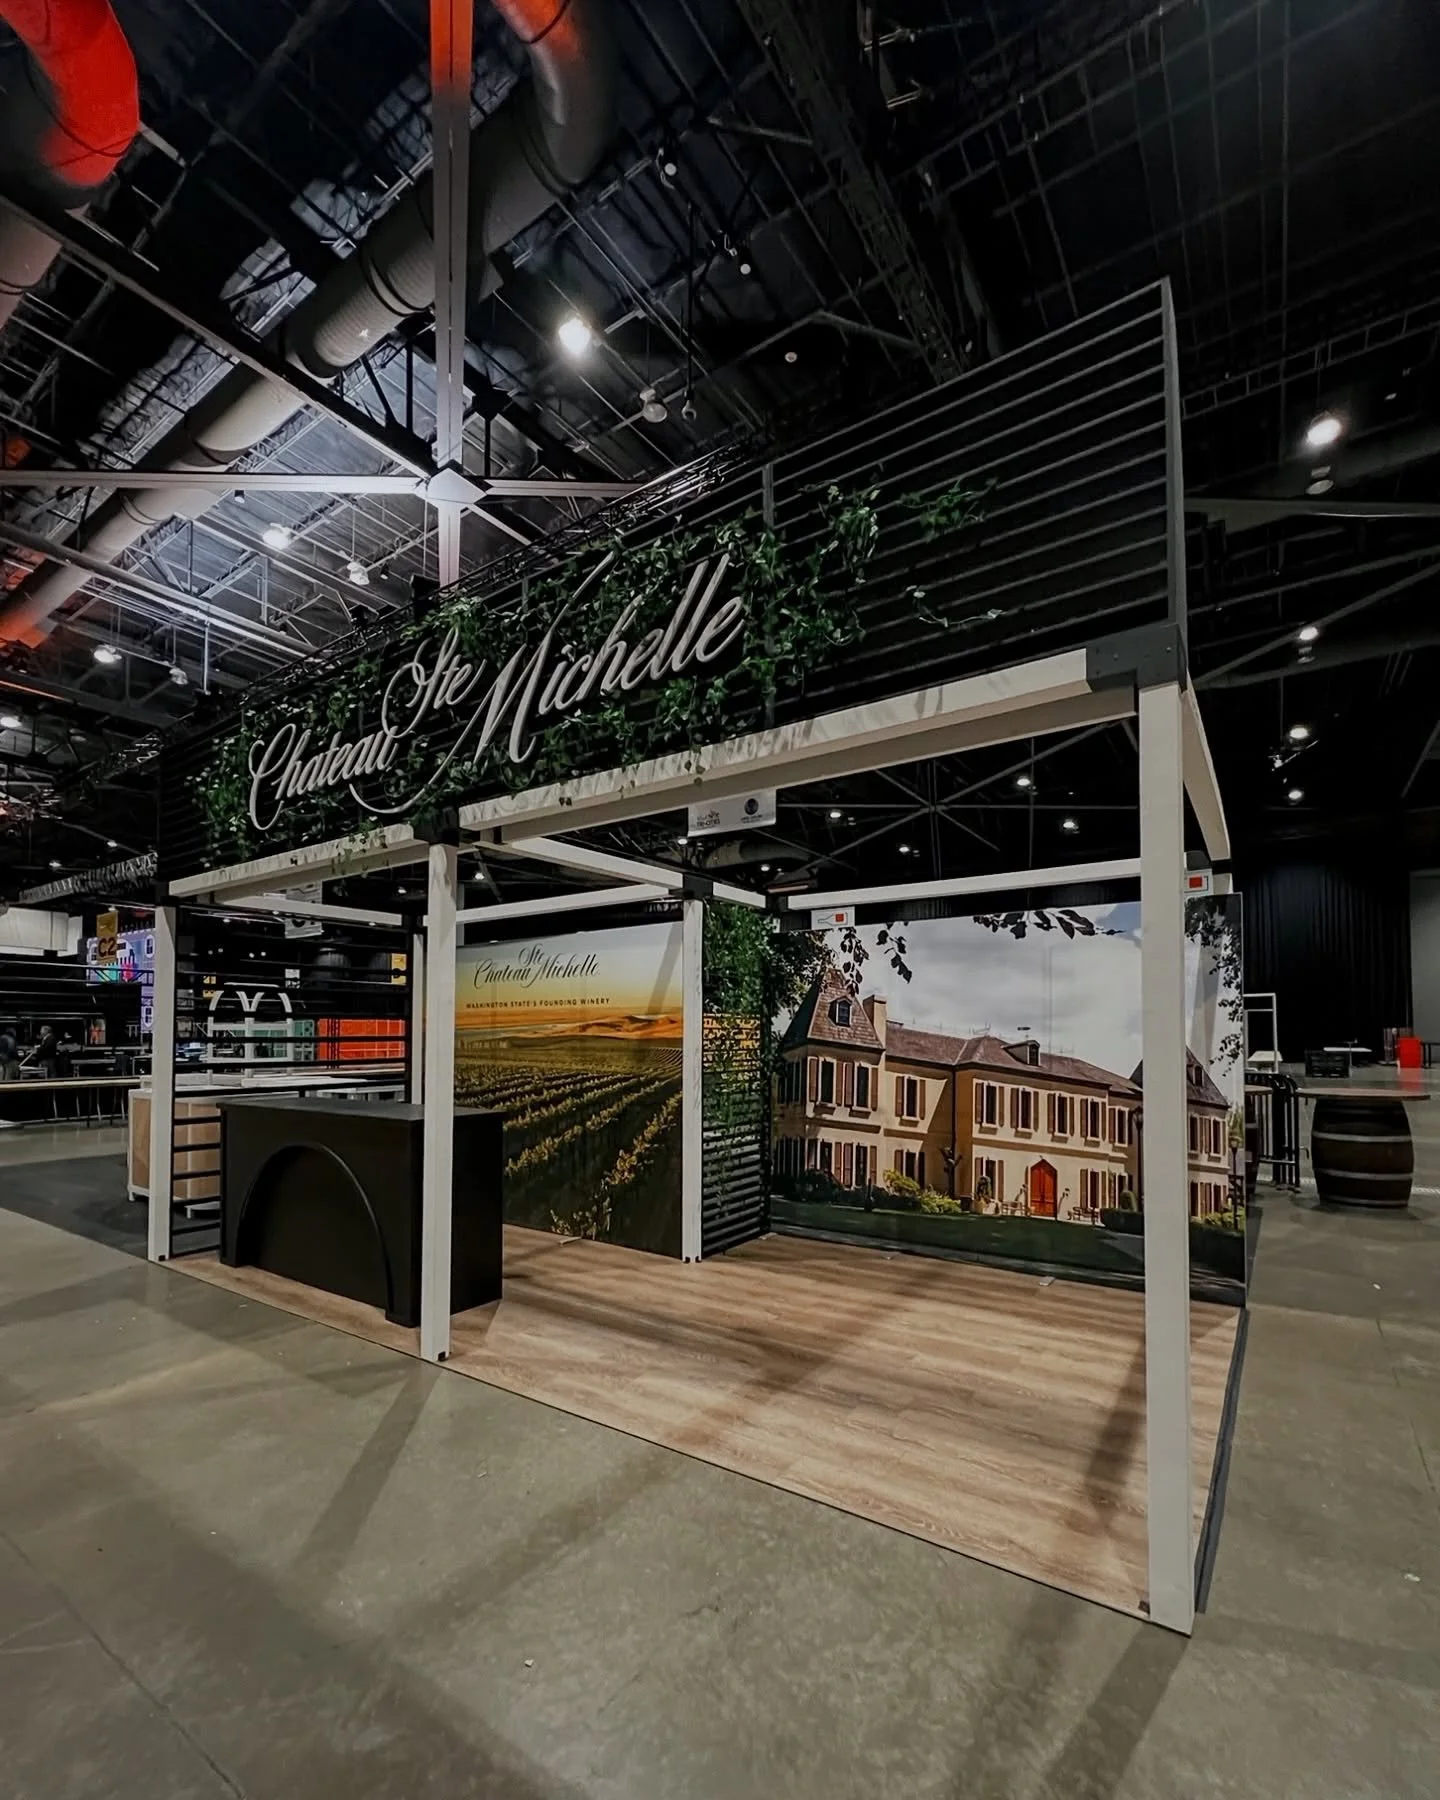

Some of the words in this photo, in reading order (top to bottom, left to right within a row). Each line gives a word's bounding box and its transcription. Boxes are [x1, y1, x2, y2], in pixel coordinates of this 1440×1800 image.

[348, 548, 746, 814] Michelle
[381, 627, 487, 738] Ste
[248, 723, 400, 831] Chateau
[98, 936, 117, 958] C2
[518, 943, 544, 968] Ste
[473, 958, 531, 990] Chateau
[520, 952, 601, 989] Michelle
[465, 1001, 508, 1009] WASHINGTON
[510, 1000, 537, 1008] STATE'S
[539, 998, 577, 1007] FOUNDING
[580, 997, 610, 1005] WINERY
